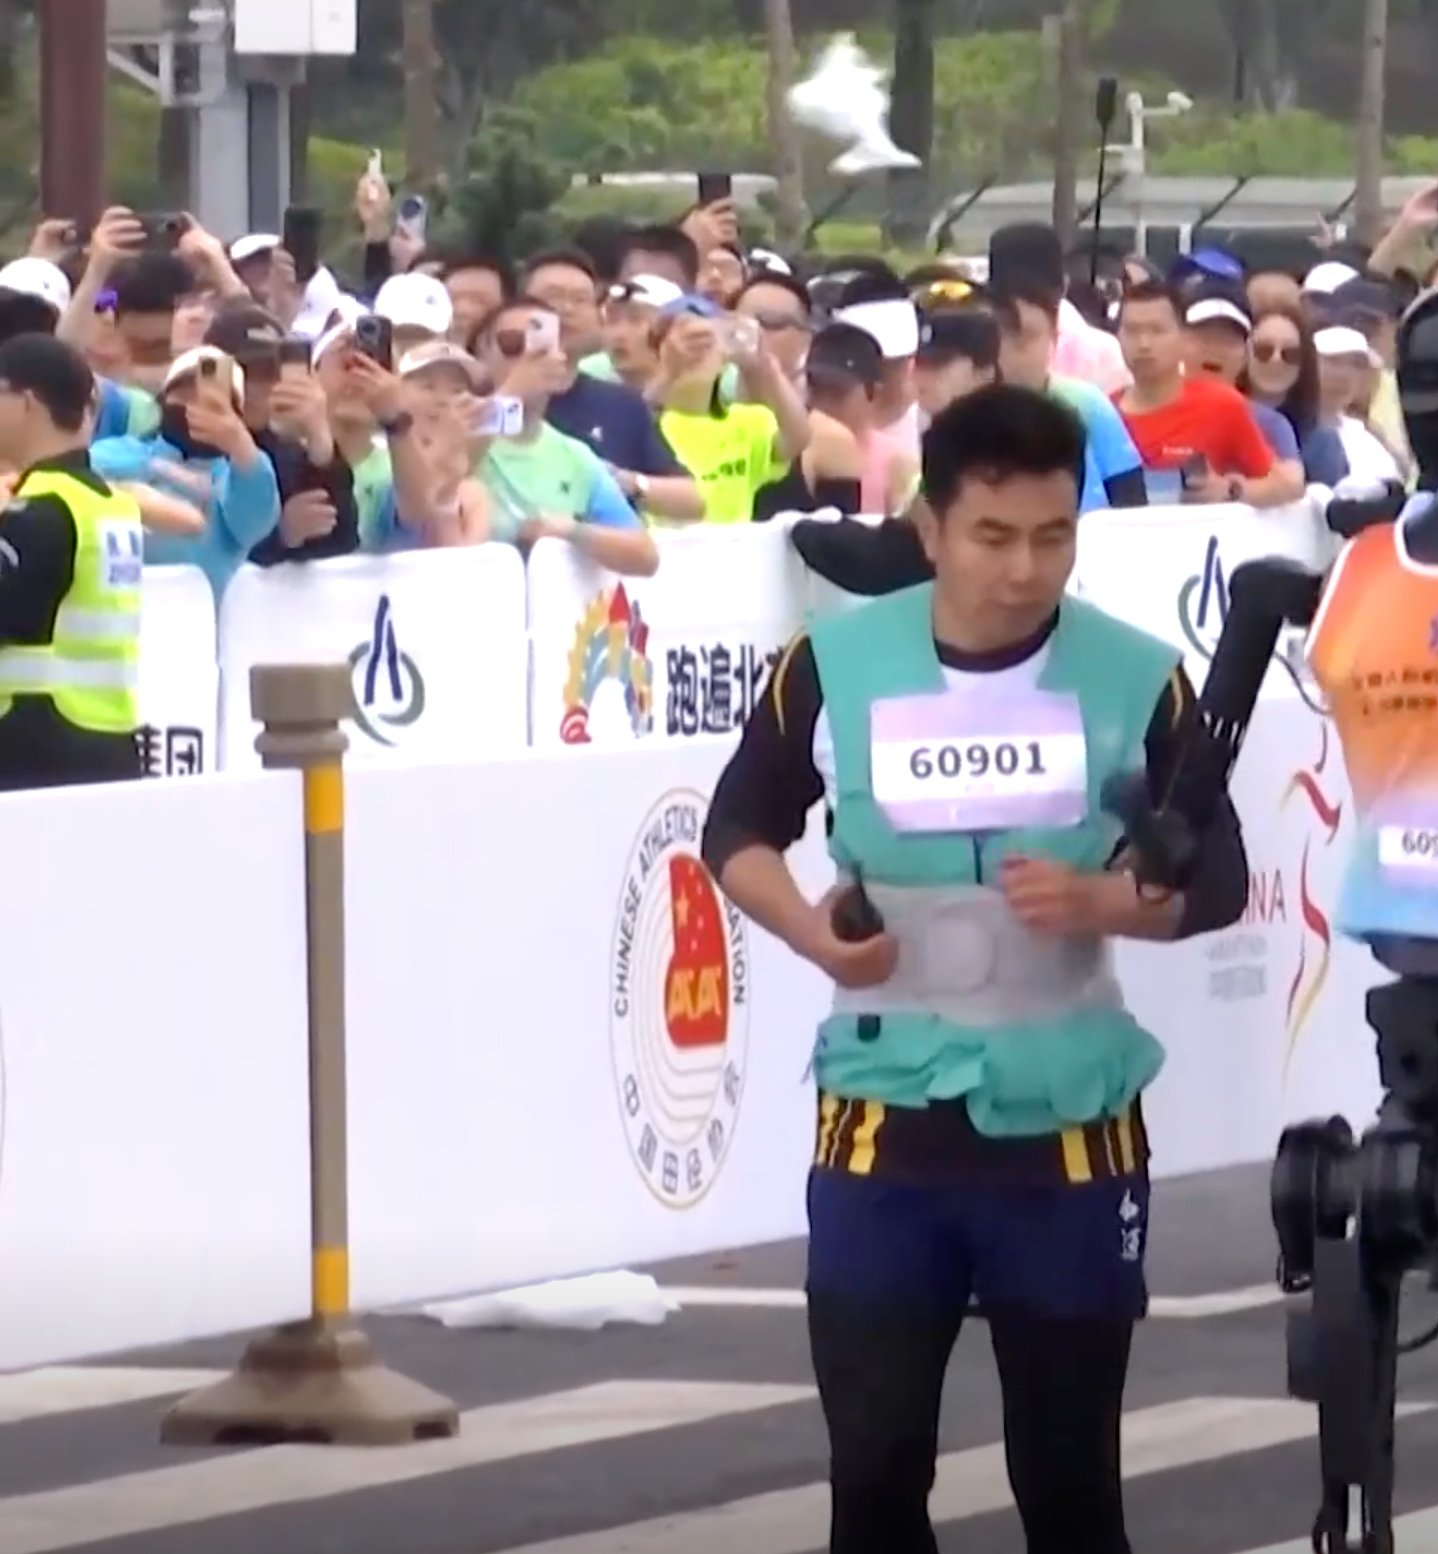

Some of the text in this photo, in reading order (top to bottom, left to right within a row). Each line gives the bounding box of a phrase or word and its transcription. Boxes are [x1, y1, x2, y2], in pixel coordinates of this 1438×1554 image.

[667, 643, 783, 737] 跑遍北
[910, 742, 1046, 779] 60901
[614, 876, 642, 1018] CHINESE
[638, 804, 697, 879] ATHLETICS
